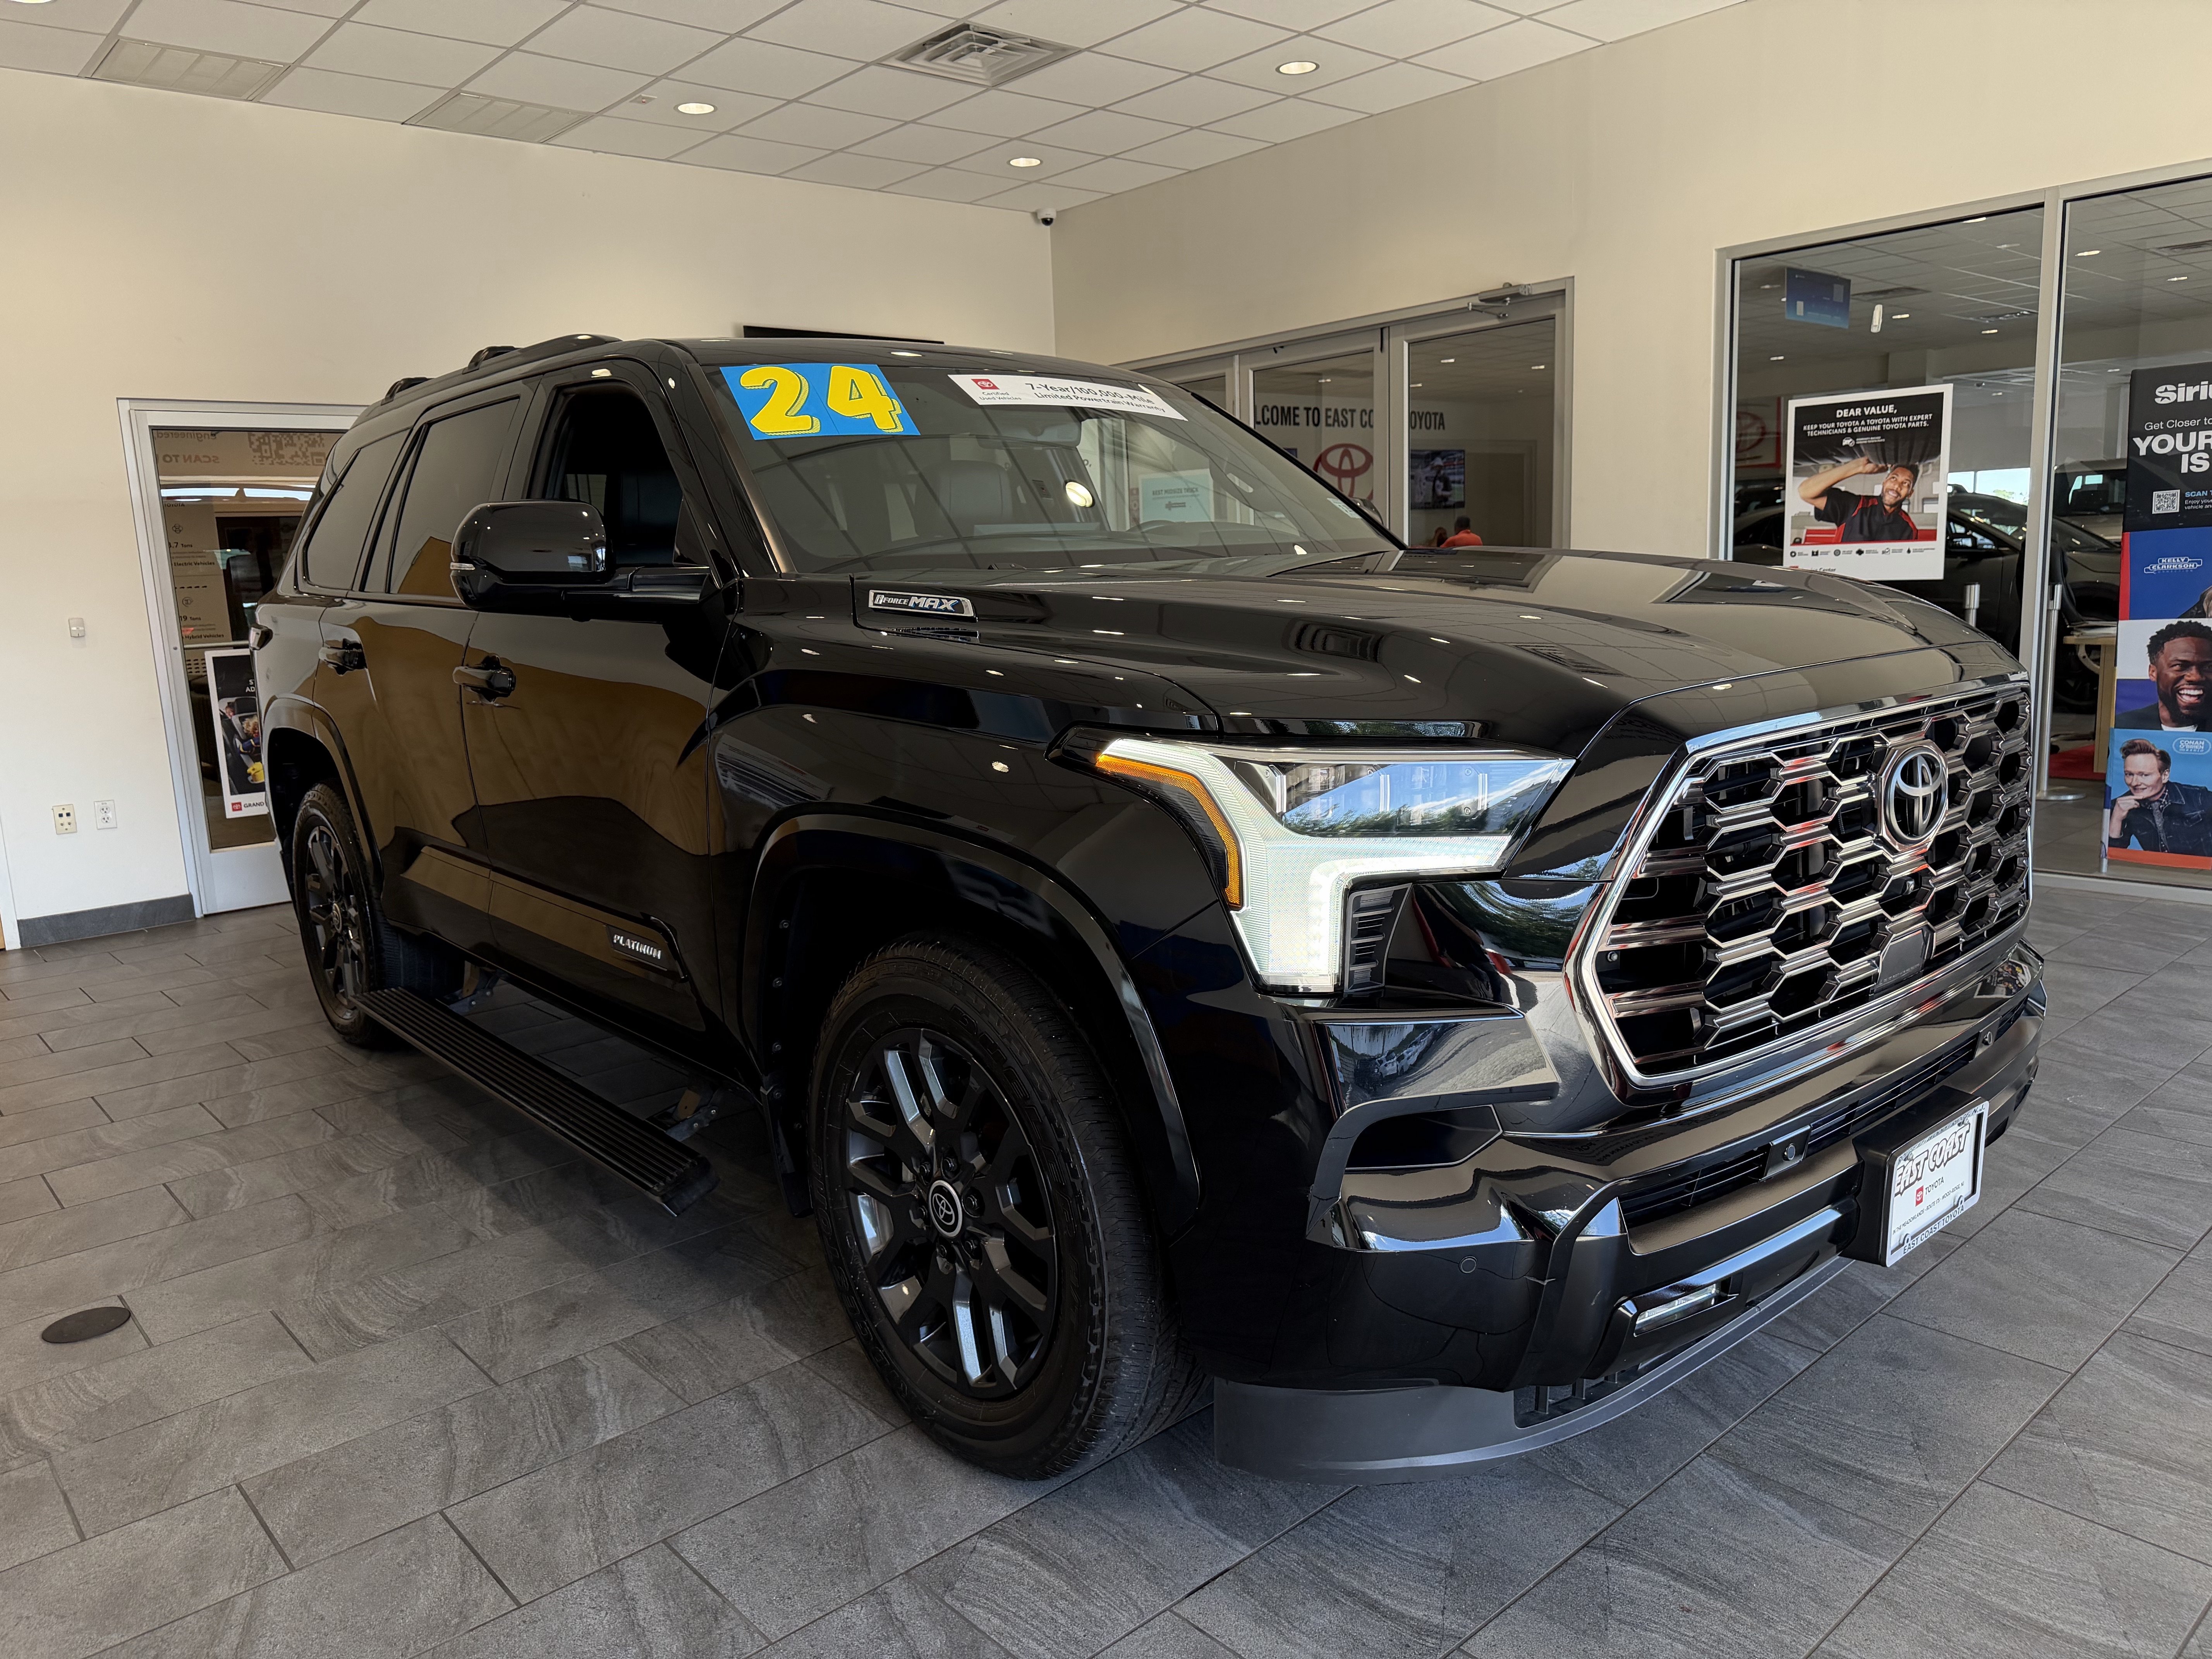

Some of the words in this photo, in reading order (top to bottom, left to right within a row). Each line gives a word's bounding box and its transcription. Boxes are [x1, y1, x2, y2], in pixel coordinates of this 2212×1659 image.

[740, 365, 903, 434] 24
[1025, 383, 1154, 404] 7-Year/100,000-Mile
[1074, 395, 1126, 405] Powertrain
[1126, 400, 1166, 413] Warranty
[1304, 406, 1320, 427] TO
[1325, 408, 1357, 428] EAST
[1410, 410, 1445, 430] OYOTA
[1836, 407, 1862, 418] DEAR
[1863, 404, 1898, 416] VALUE,
[1836, 421, 1860, 429] TOYOTA
[1909, 413, 1933, 422] EXPERT
[1807, 429, 1846, 437] TECHNICIANS
[1853, 425, 1881, 433] GENUINE
[1908, 420, 1929, 428] PARTS.
[2145, 421, 2164, 431] Get
[2167, 419, 2201, 428] Closer
[2133, 430, 2212, 456] YOUR
[2181, 452, 2210, 474] IS
[908, 596, 958, 612] MAX
[613, 934, 662, 960] PLATINUM
[1972, 1104, 1985, 1115] N.J.
[1894, 1149, 1929, 1197] EAST
[1928, 1123, 1971, 1173] COAST
[1925, 1176, 1944, 1195] TOYOTA
[1902, 1208, 1925, 1229] MEADOWLANDS
[1903, 1237, 1920, 1255] EAST
[1920, 1220, 1941, 1242] COAST
[1942, 1204, 1964, 1226] TOYOTA
